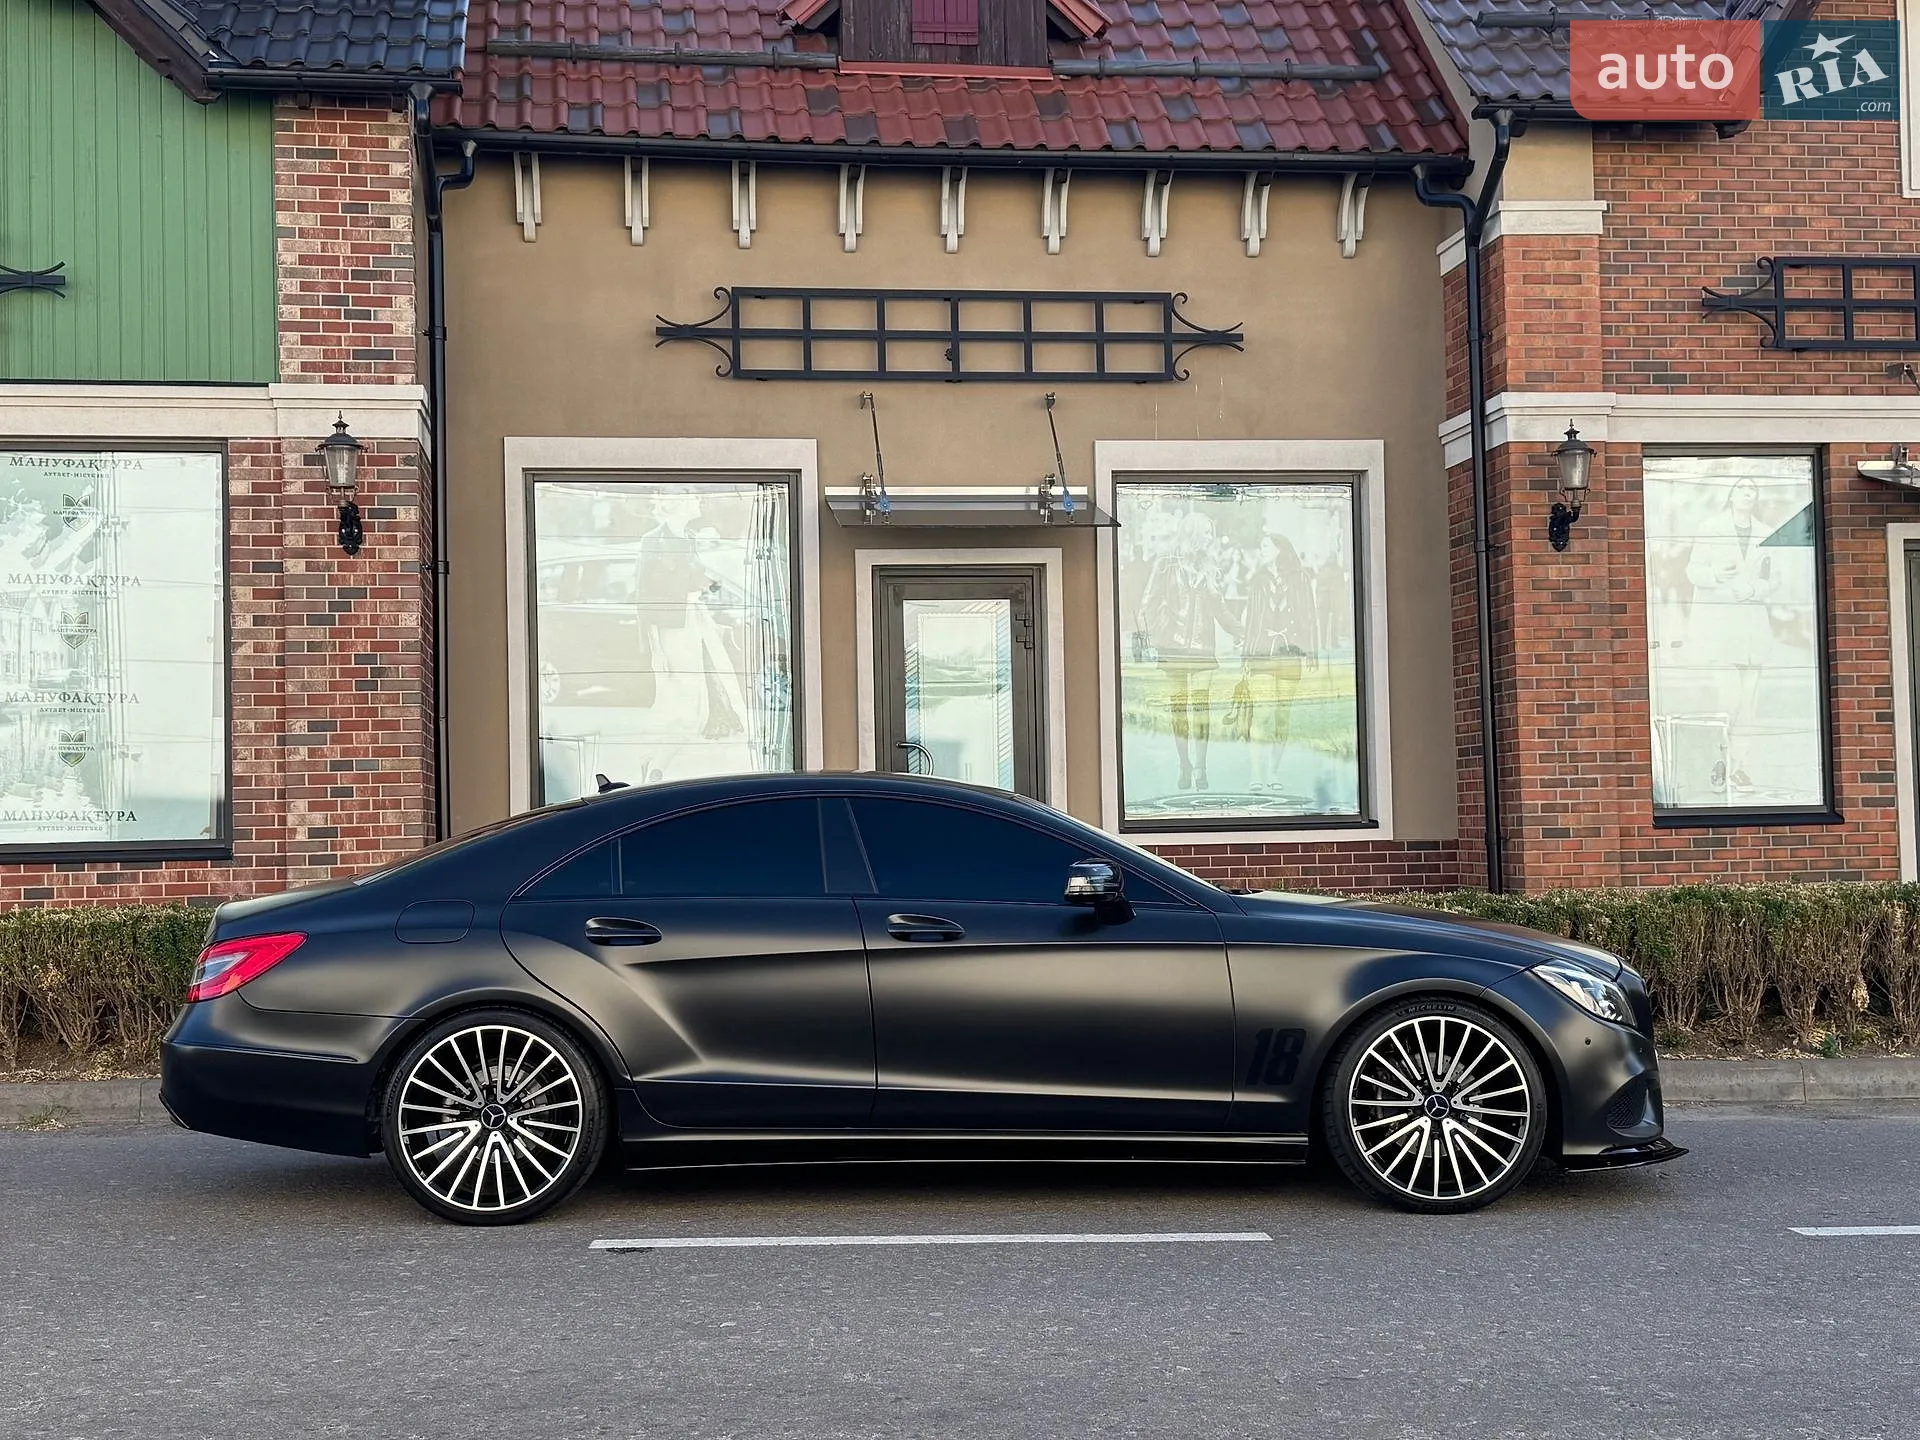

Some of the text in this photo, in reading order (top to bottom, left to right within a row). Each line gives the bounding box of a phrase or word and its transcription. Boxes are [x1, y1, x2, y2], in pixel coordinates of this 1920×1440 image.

[9, 457, 144, 471] МАНУФАКТУРА
[7, 573, 142, 588] МАНУФАКТУРА
[5, 691, 140, 706] МАНУФАКТУРА
[3, 809, 137, 823] МАНУФАКТУРА
[1408, 1003, 1457, 1014] MICHELIN
[1246, 1028, 1308, 1086] 18
